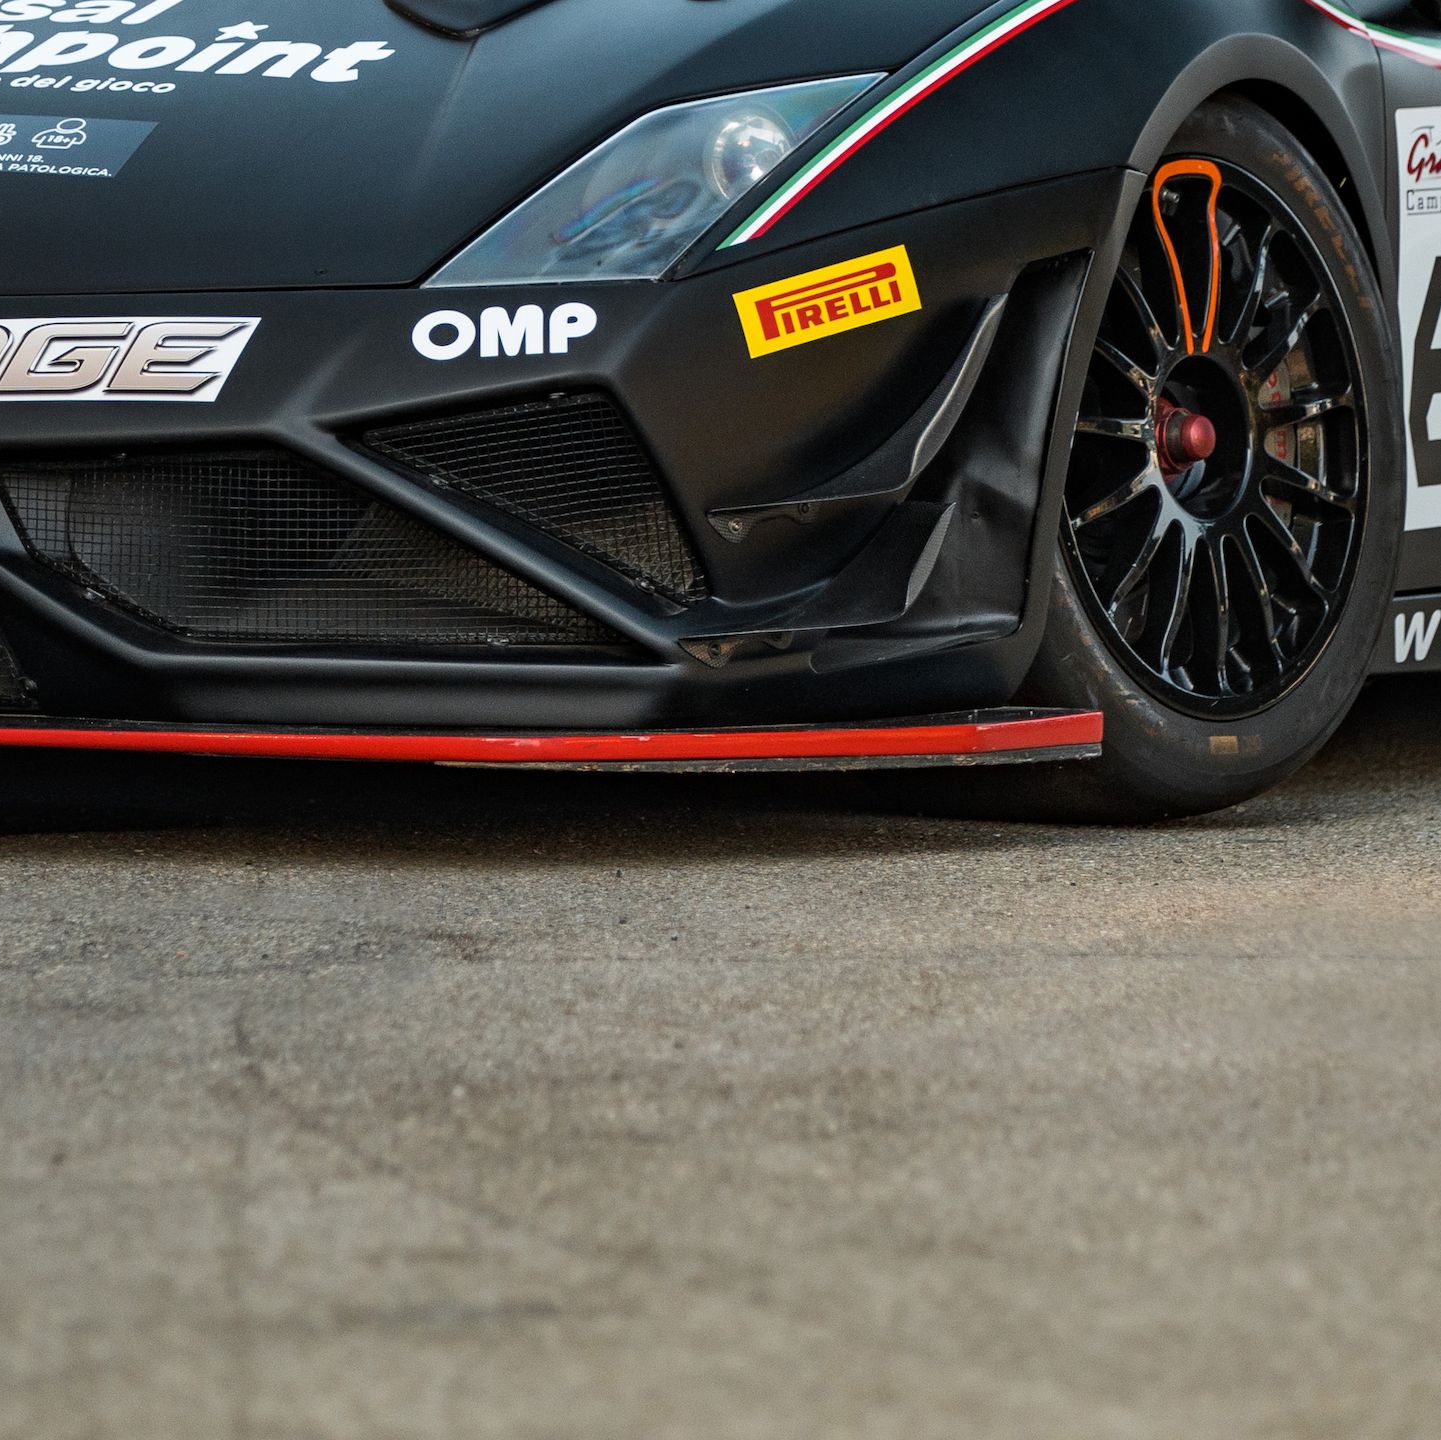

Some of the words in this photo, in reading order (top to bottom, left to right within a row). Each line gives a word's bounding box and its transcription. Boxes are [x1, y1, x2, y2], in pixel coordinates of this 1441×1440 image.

[9, 73, 73, 90] del
[70, 76, 177, 94] gioco
[26, 154, 45, 163] 18.
[7, 163, 114, 178] PATOLOGICA.
[755, 261, 902, 341] PIRELLI
[411, 302, 598, 361] OMP
